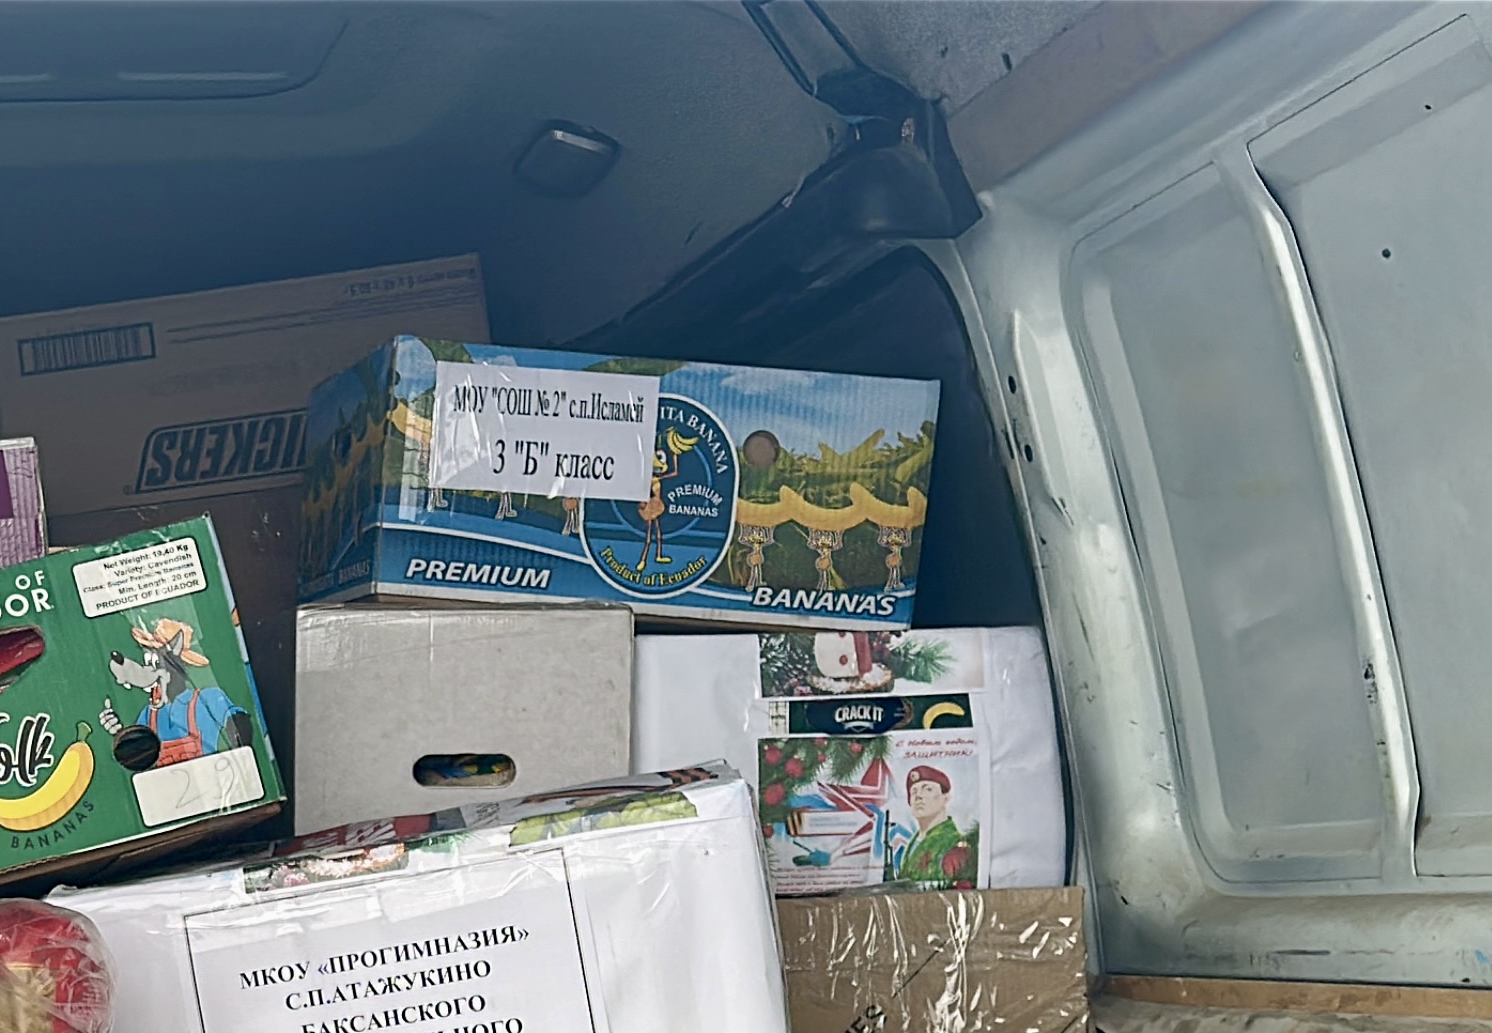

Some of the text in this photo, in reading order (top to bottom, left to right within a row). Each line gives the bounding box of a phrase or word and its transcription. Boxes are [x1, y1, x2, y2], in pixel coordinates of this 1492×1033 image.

[454, 385, 487, 413] МОУ
[492, 386, 532, 416] "СОШ
[553, 390, 566, 417] 2"
[145, 414, 308, 486] ICKERS
[687, 413, 729, 474] BANANA
[493, 439, 614, 480] 3 "Б" класс
[667, 484, 723, 505] PREMIUM
[669, 504, 719, 517] BANANAS
[148, 553, 192, 569] Cavendish
[176, 544, 189, 553] Kg
[15, 570, 46, 590] OF
[406, 558, 550, 589] PREMIUM
[600, 545, 707, 586] Product of Ecuador
[96, 594, 139, 610] PRODUCT
[753, 587, 897, 616] BANANAS
[835, 704, 871, 722] CRACK
[873, 704, 884, 721] IT
[11, 800, 95, 849] BANANAS
[239, 924, 530, 990] МКОУ «ПРОГИМНАЗИЯ»
[285, 959, 492, 1012] С.П.АТАЖУКИНО
